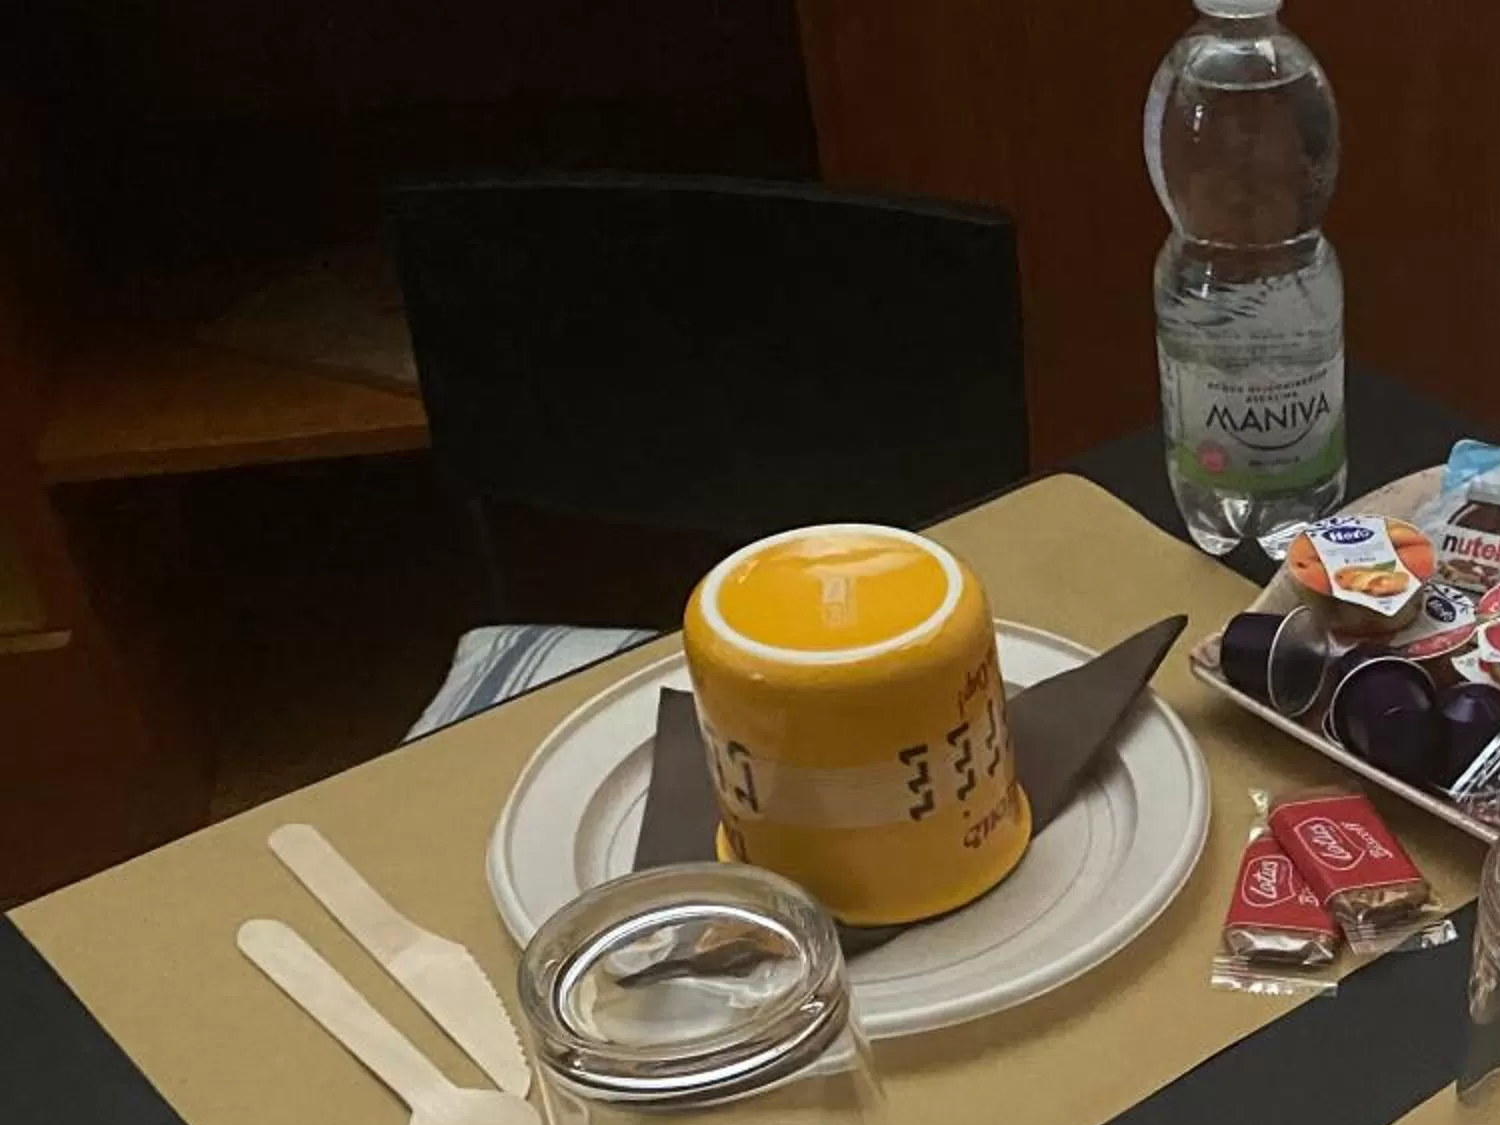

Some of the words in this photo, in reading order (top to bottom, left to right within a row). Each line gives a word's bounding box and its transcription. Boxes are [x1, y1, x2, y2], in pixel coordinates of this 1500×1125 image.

[1205, 391, 1331, 433] MANIVA
[1328, 529, 1370, 543] Hero
[1250, 860, 1278, 899] Lotus
